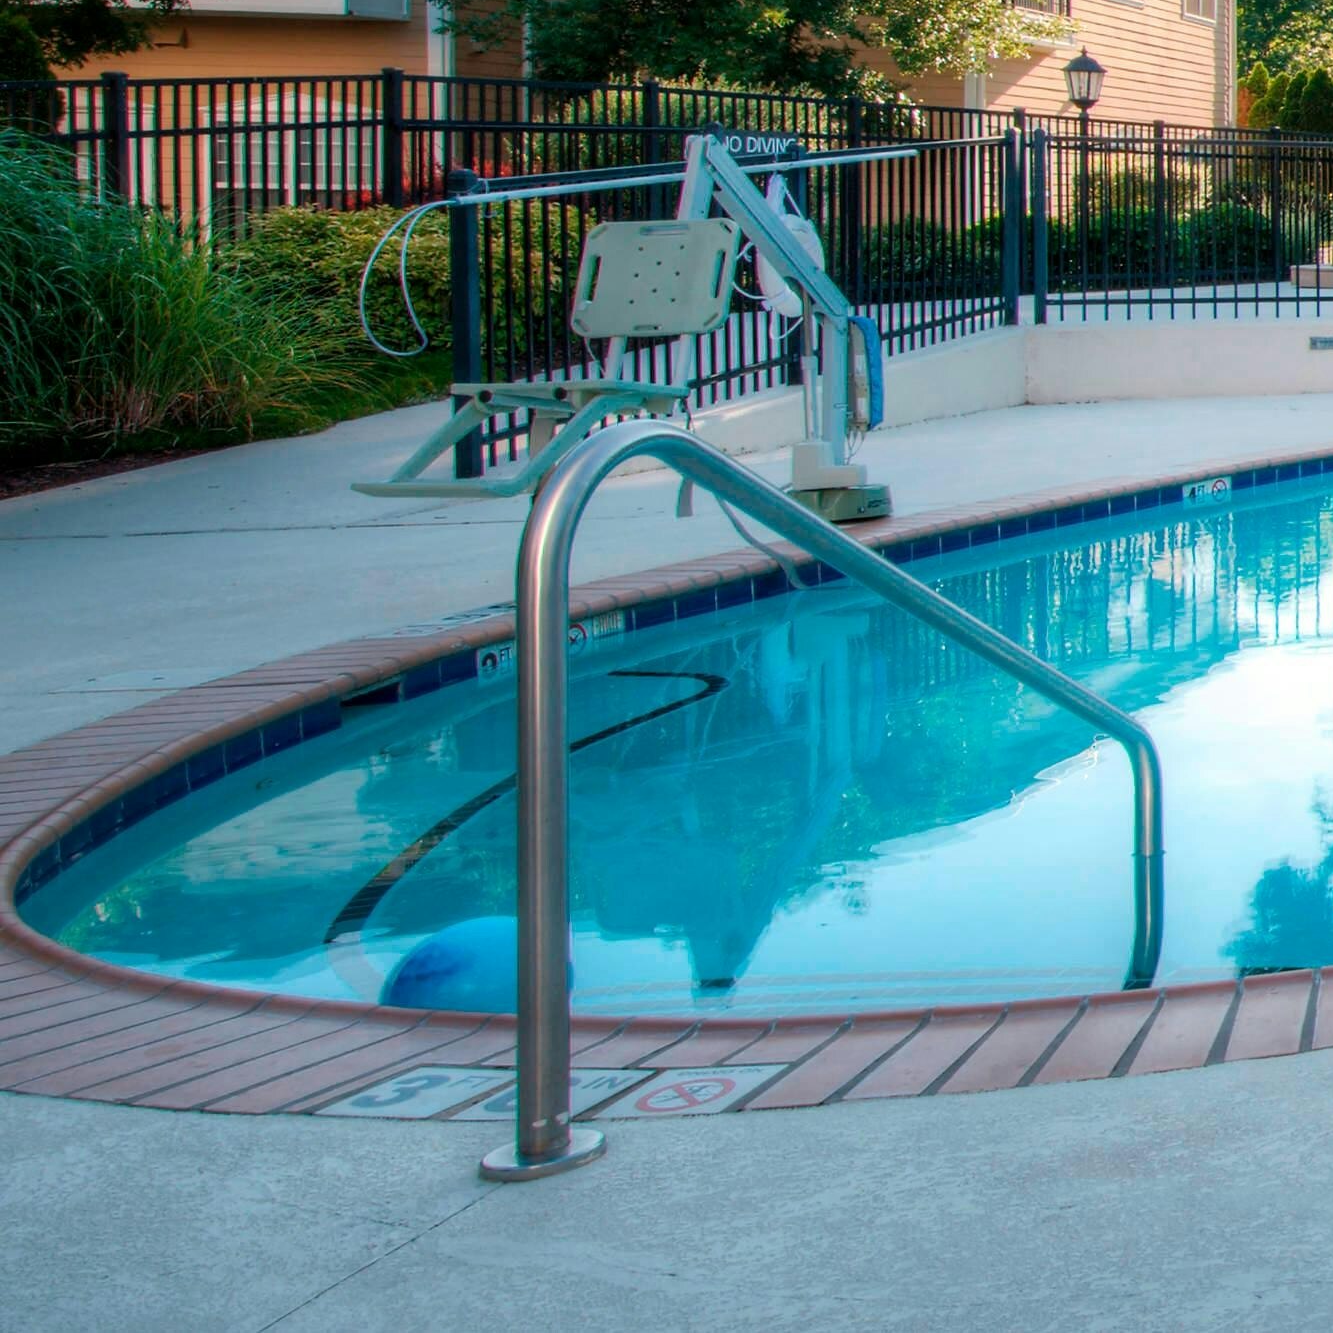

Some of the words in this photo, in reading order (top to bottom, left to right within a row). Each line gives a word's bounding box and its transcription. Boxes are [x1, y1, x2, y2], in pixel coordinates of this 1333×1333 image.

[351, 1075, 450, 1108] 3
[448, 1075, 502, 1090] FT
[581, 1077, 631, 1091] IN
